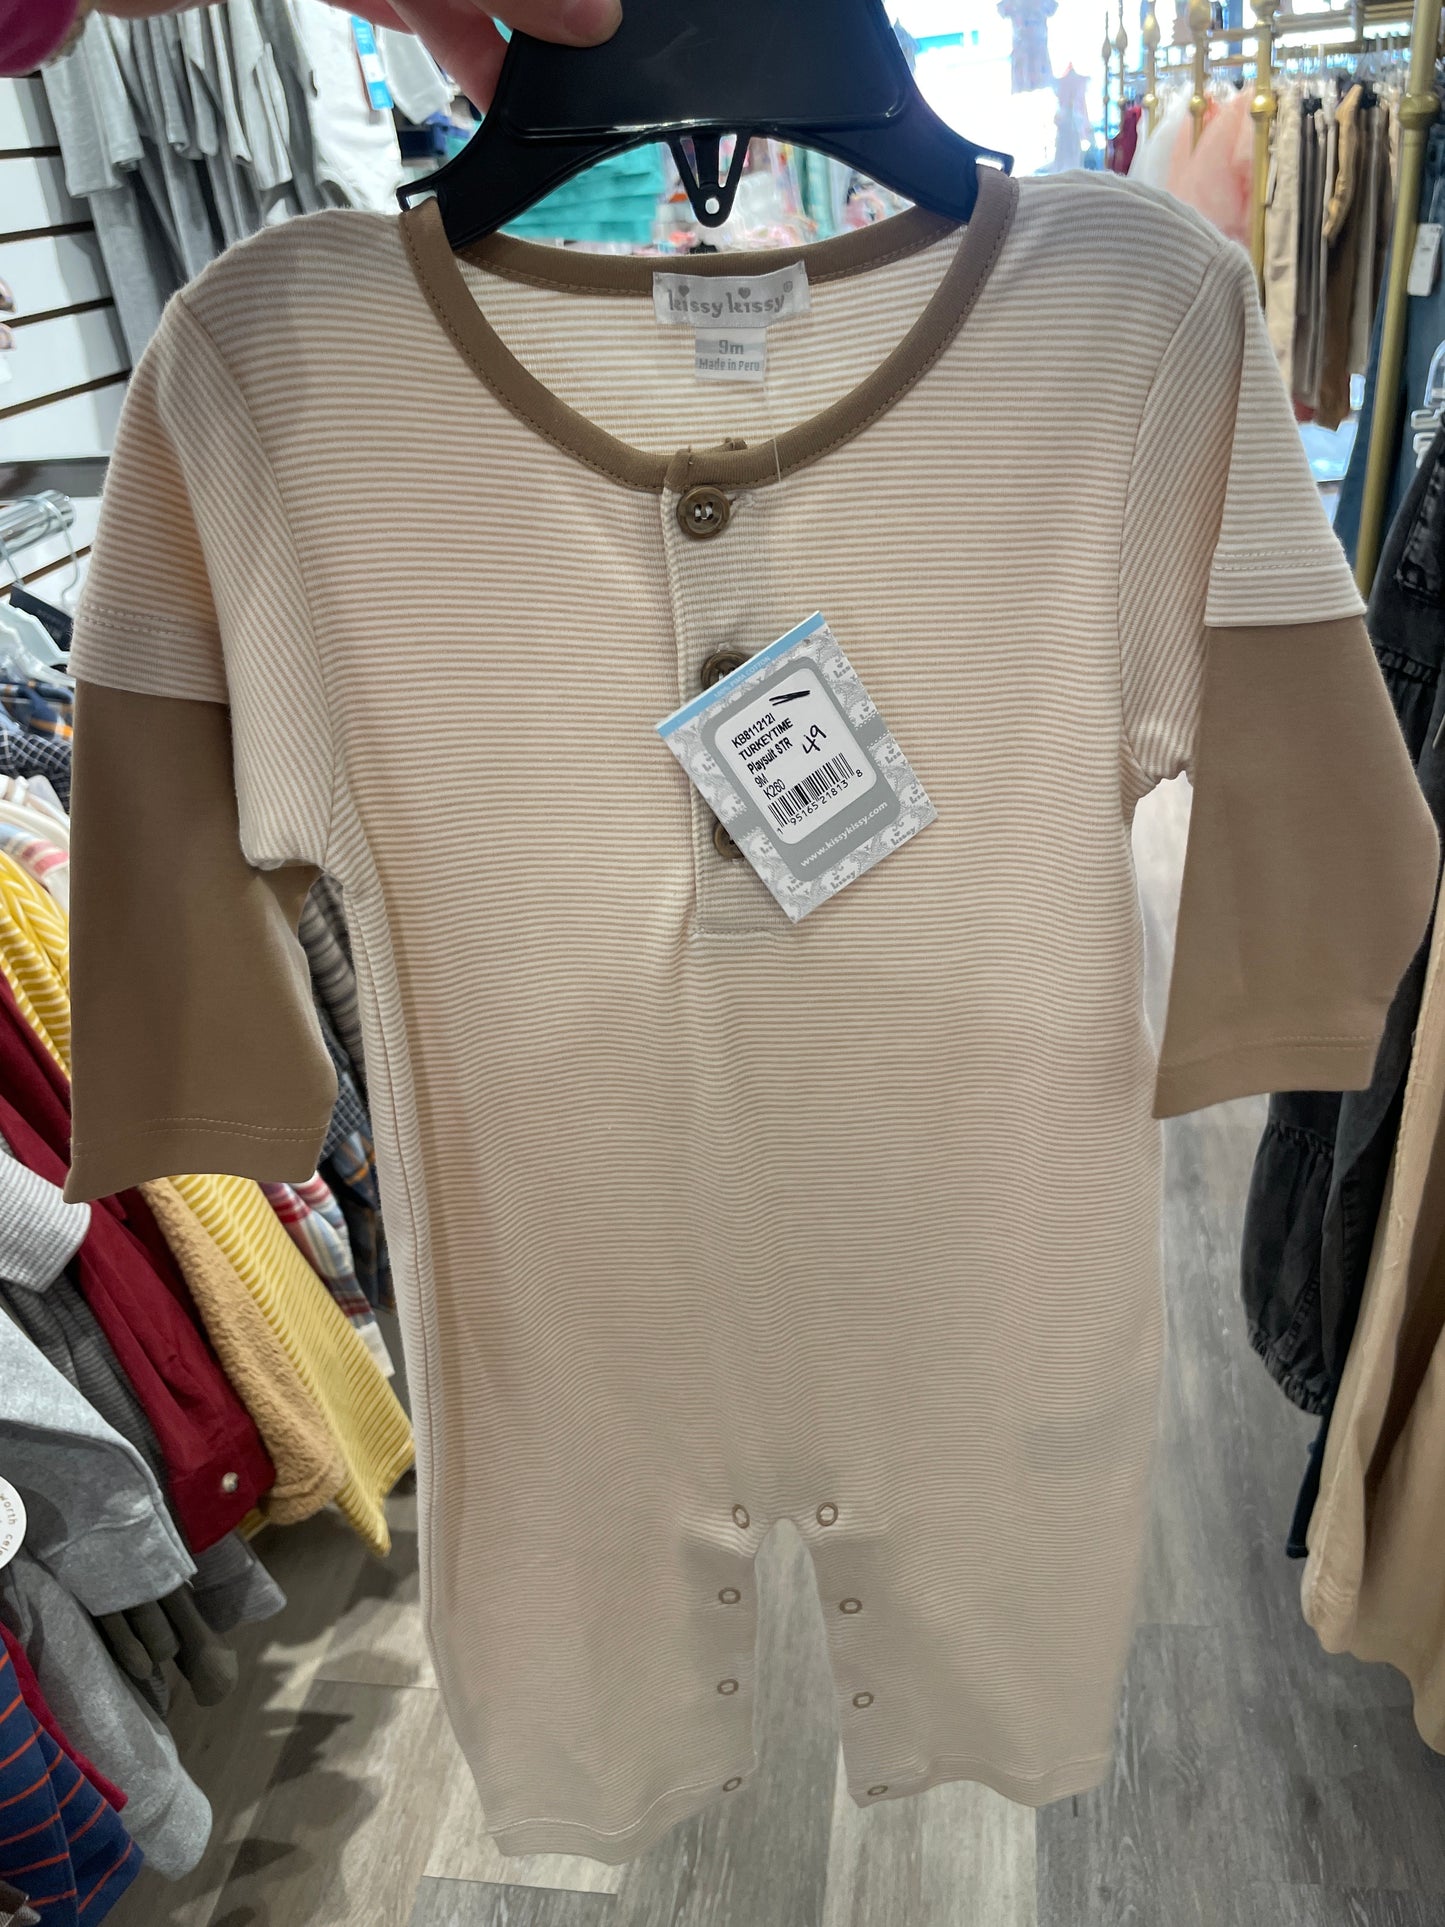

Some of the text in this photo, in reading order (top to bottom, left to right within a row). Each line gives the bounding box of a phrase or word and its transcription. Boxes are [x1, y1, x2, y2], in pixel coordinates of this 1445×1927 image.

[668, 284, 723, 318] kissy
[718, 339, 745, 355] 9m
[699, 357, 761, 372] Made in Peru
[738, 717, 793, 761] TURKEYTIME
[747, 736, 793, 775] Playsuit STR
[754, 772, 769, 788] 9M
[763, 778, 786, 800] K260
[776, 768, 864, 835] 1 95165 21813 8
[800, 801, 889, 868] www.kissykissy.com
